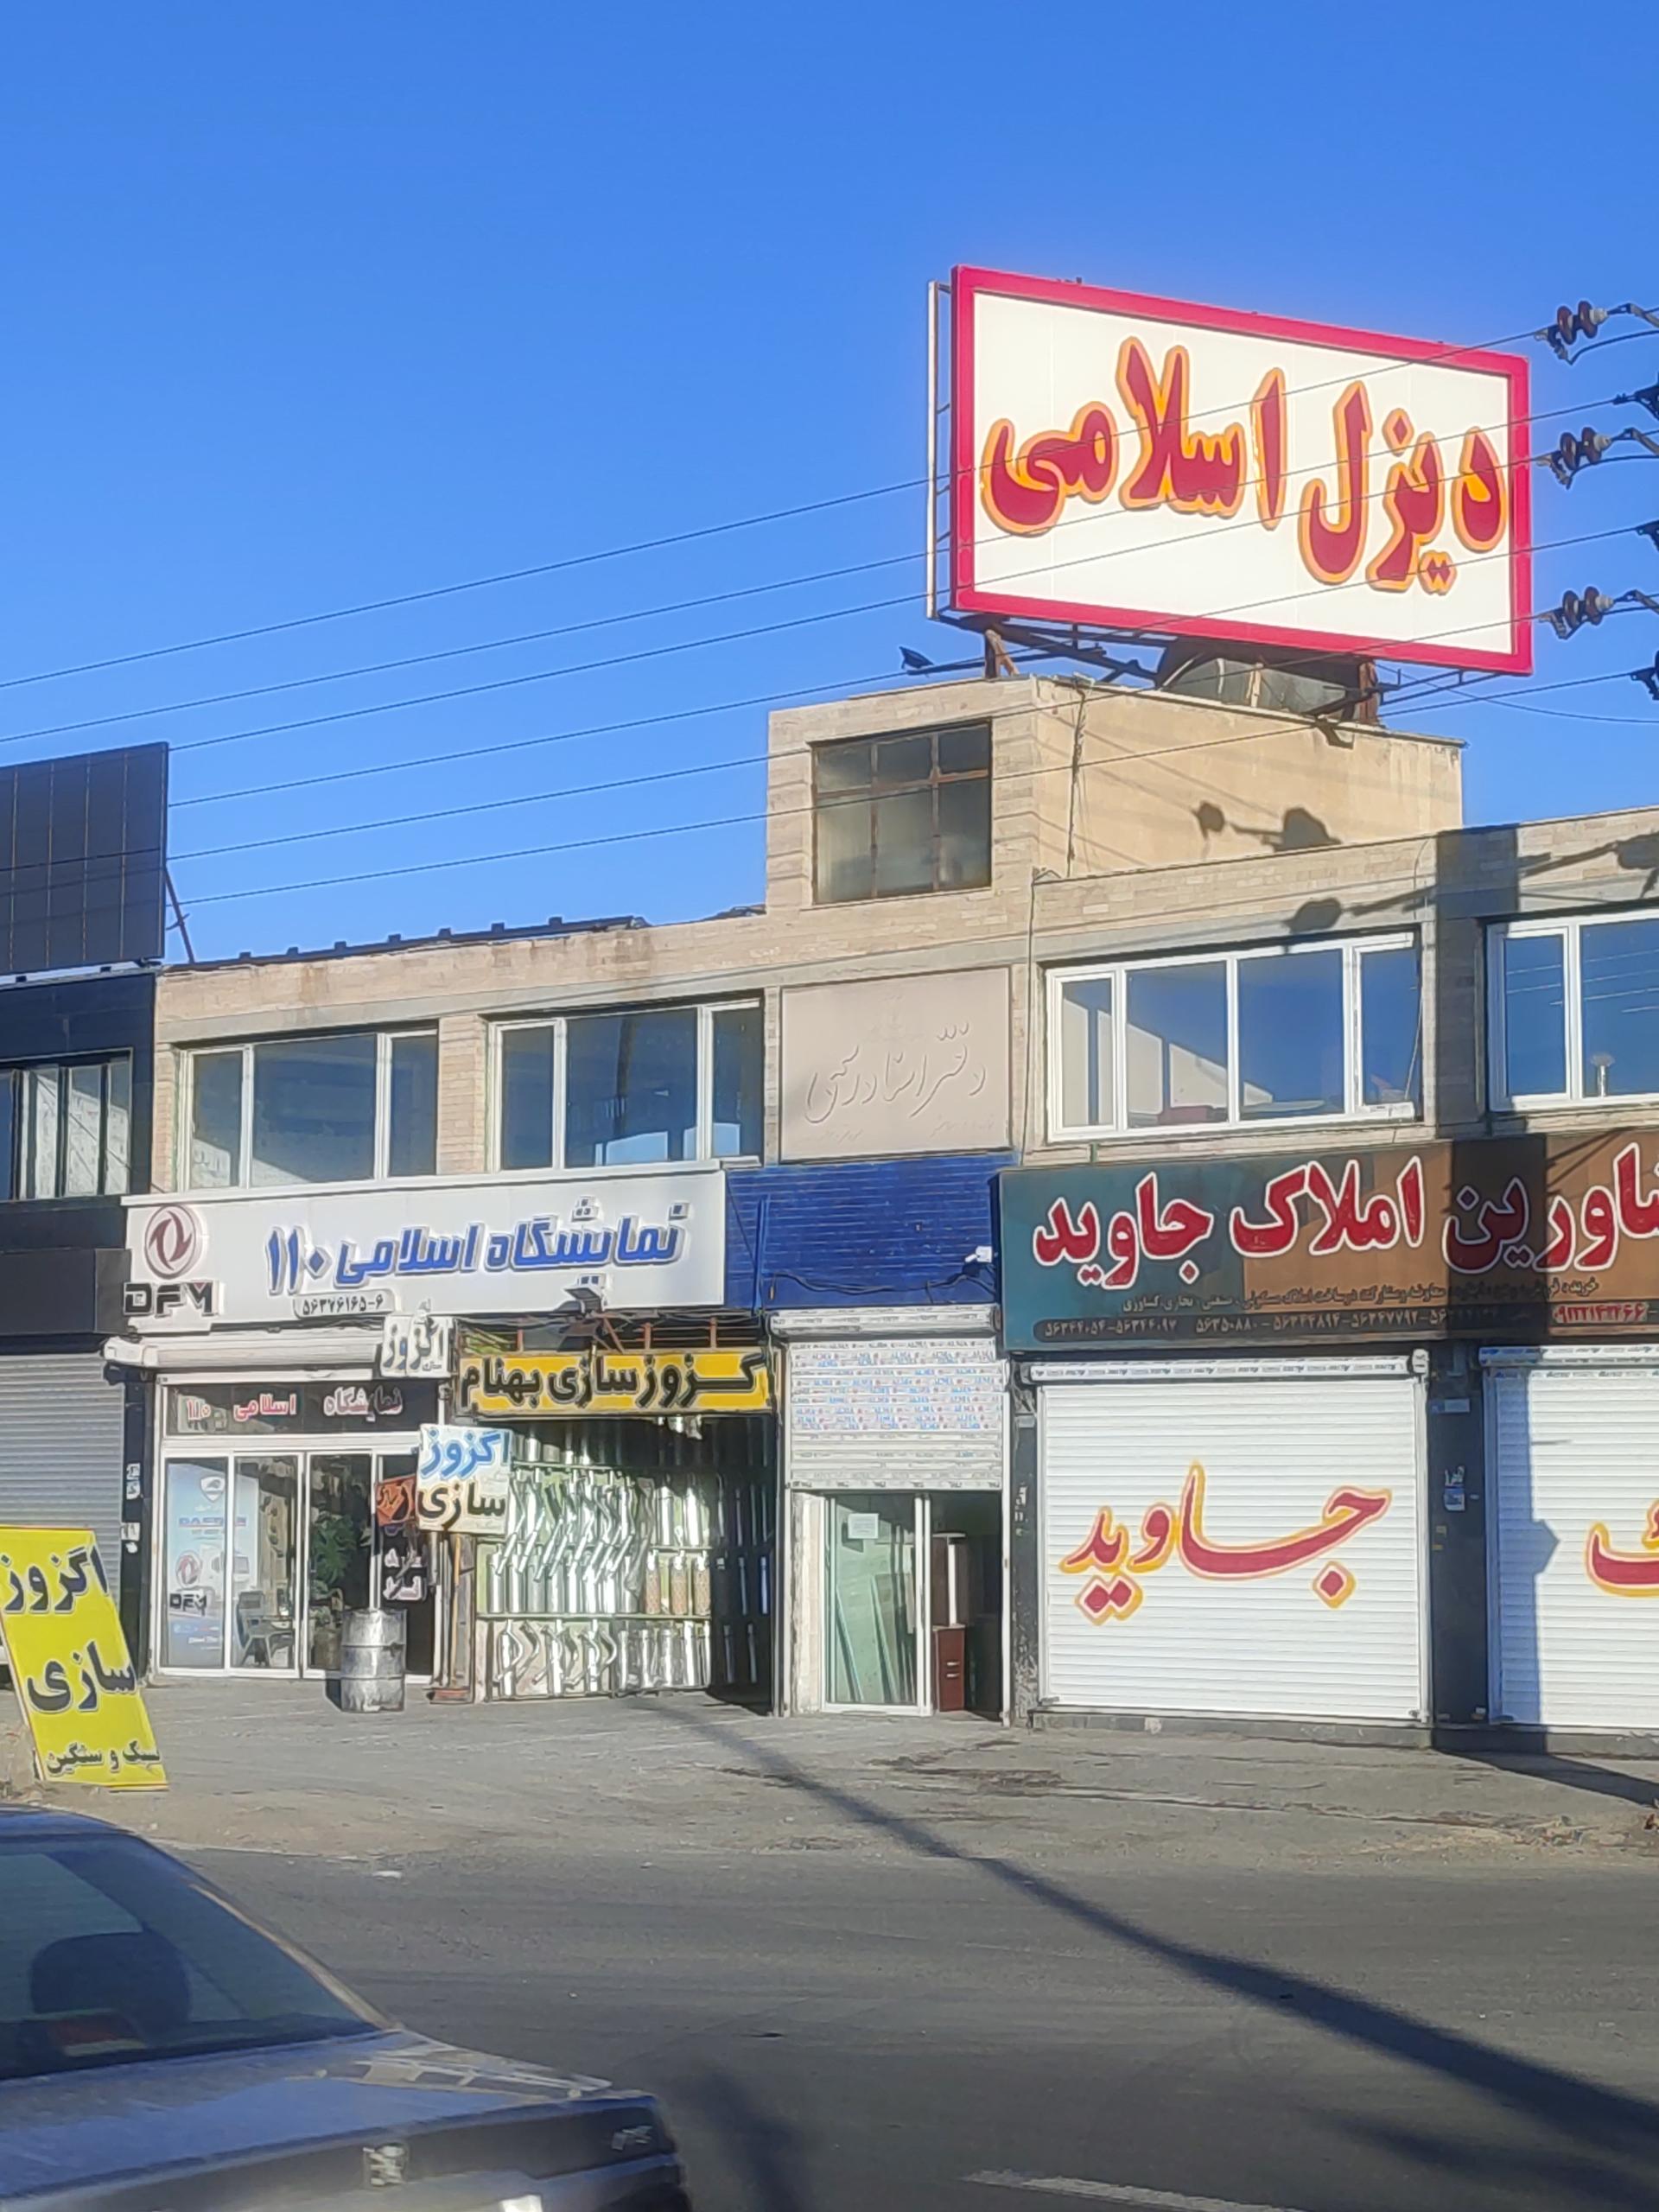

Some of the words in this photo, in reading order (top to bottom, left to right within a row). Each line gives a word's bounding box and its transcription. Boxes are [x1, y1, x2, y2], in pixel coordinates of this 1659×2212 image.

[982, 335, 1289, 537] اسلامی
[1299, 380, 1509, 596] دیزل
[486, 1196, 688, 1286] نمایشگاه
[1033, 1171, 1214, 1289] جاوید
[1230, 1156, 1424, 1258] املاک
[1442, 1142, 1659, 1274] اورین
[266, 1227, 330, 1294] ۱۱۰
[334, 1224, 482, 1287] اسلامی
[124, 1280, 219, 1317] DFM
[232, 1392, 297, 1422] اسلامی
[461, 1354, 543, 1409] بهنام
[420, 1427, 511, 1480] اگزوز
[418, 1481, 506, 1533] سازی
[1058, 1459, 1393, 1626] جاوید
[0, 1545, 109, 1614] اگزوز
[27, 1640, 138, 1714] سازی
